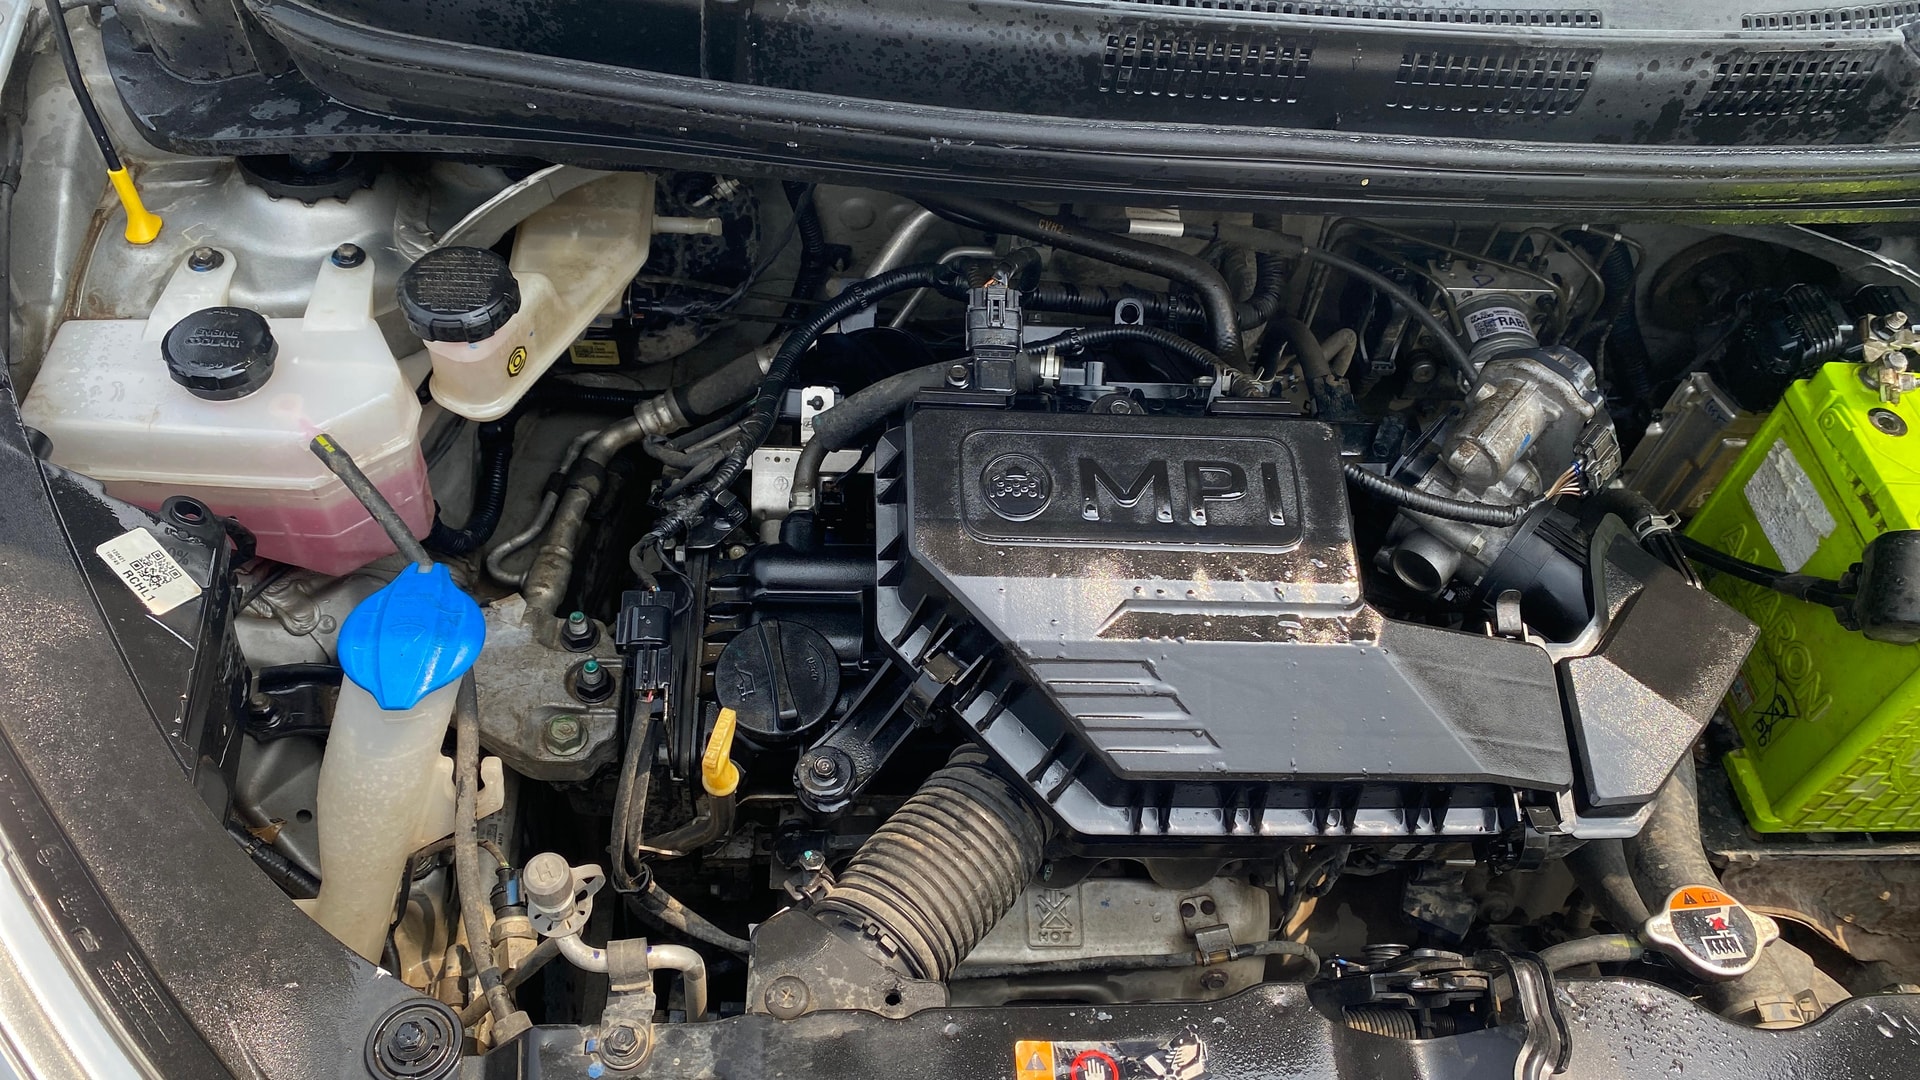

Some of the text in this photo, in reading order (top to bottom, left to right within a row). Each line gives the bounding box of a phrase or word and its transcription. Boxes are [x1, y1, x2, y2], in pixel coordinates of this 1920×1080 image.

[194, 327, 240, 338] ENGINE
[185, 337, 244, 349] COOLANT
[1078, 457, 1286, 526] MPI
[1038, 931, 1072, 942] HOT
